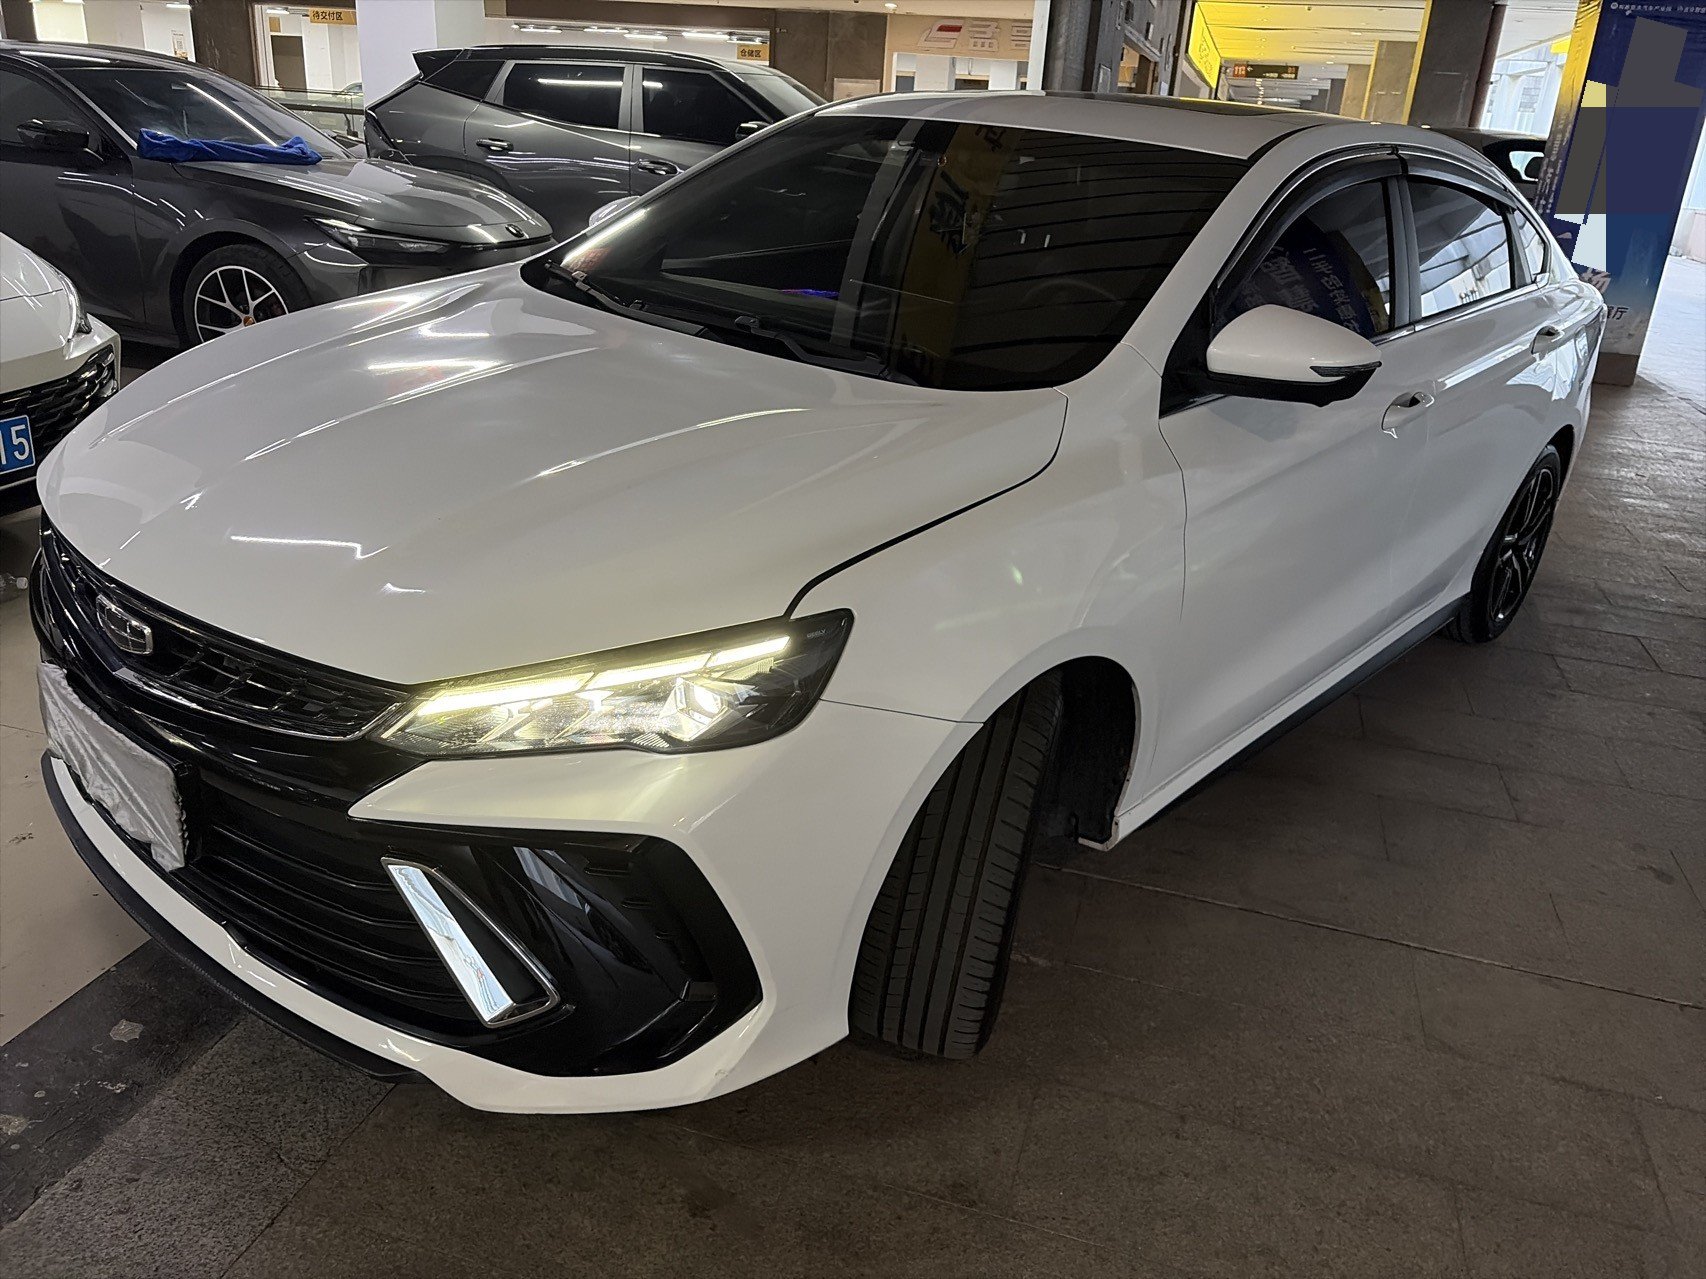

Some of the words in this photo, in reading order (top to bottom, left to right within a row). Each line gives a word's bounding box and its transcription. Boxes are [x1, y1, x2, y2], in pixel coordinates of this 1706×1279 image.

[312, 10, 344, 21] 待交付区
[740, 48, 762, 58] 仓储区
